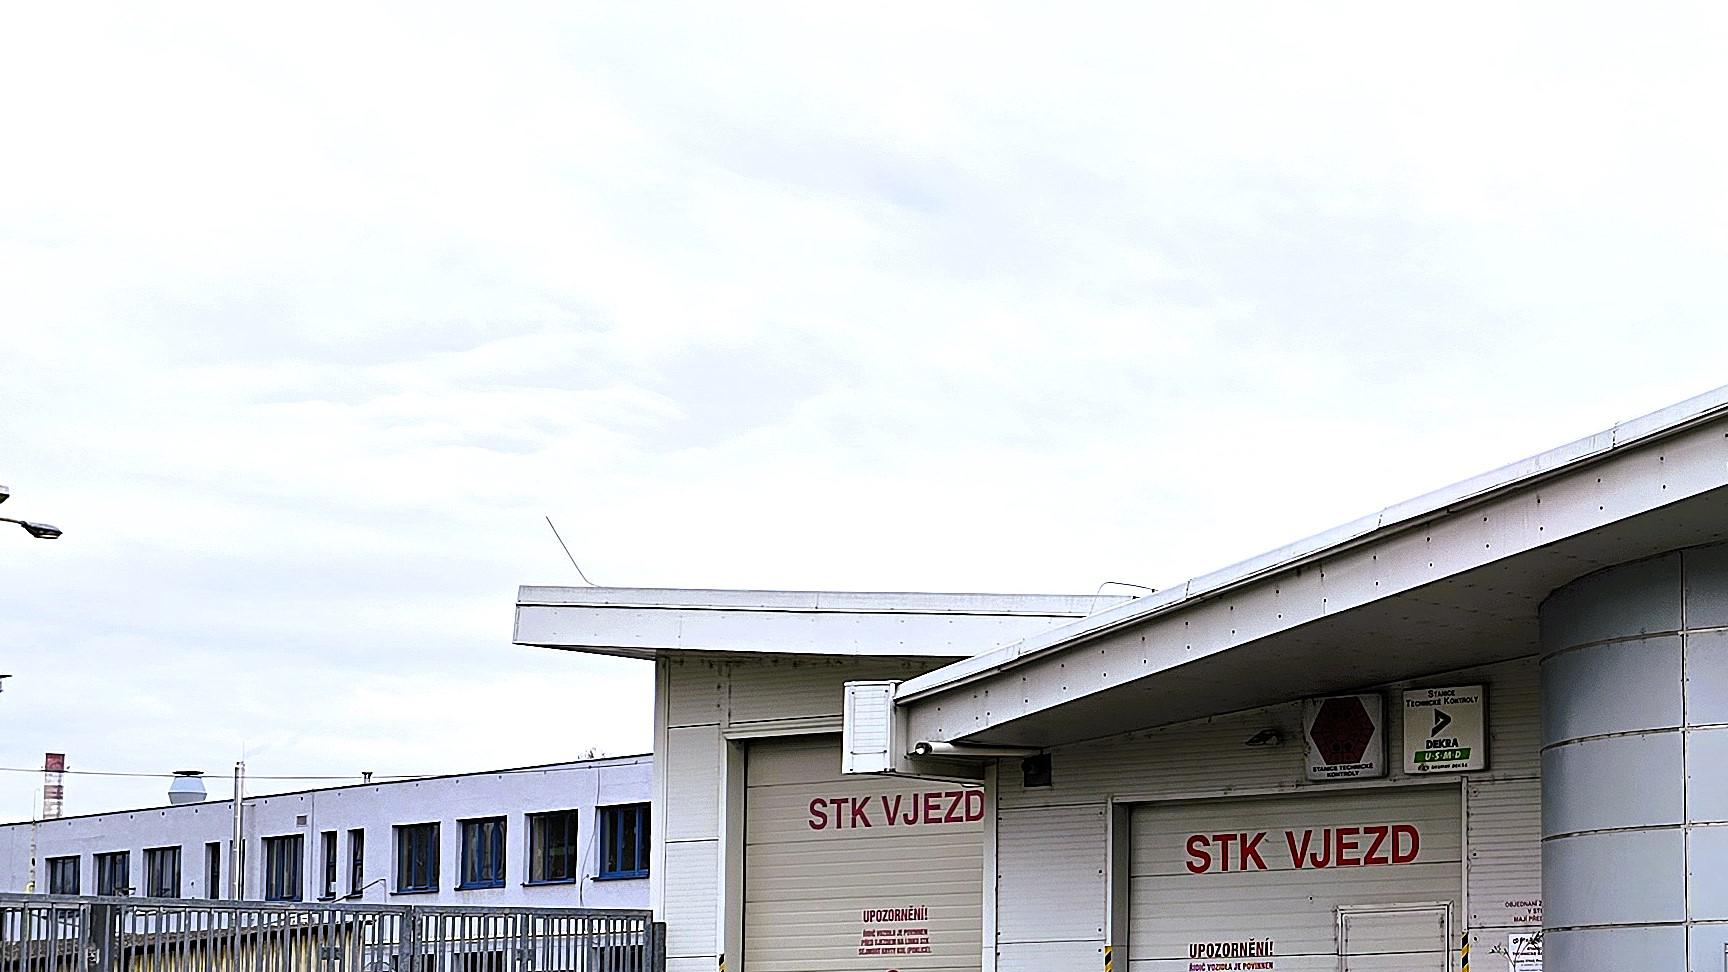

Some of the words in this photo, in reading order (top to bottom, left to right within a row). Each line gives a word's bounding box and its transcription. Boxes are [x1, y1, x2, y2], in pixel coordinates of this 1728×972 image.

[1426, 738, 1458, 749] DEKRA
[808, 796, 873, 830] STK
[881, 789, 986, 826] VJEZD
[1186, 832, 1268, 874] STK
[1285, 825, 1420, 869] VJEZD
[863, 904, 928, 922] UPOZORNĚNÍ!
[1189, 937, 1274, 958] UPOZORNĚNÍ!
